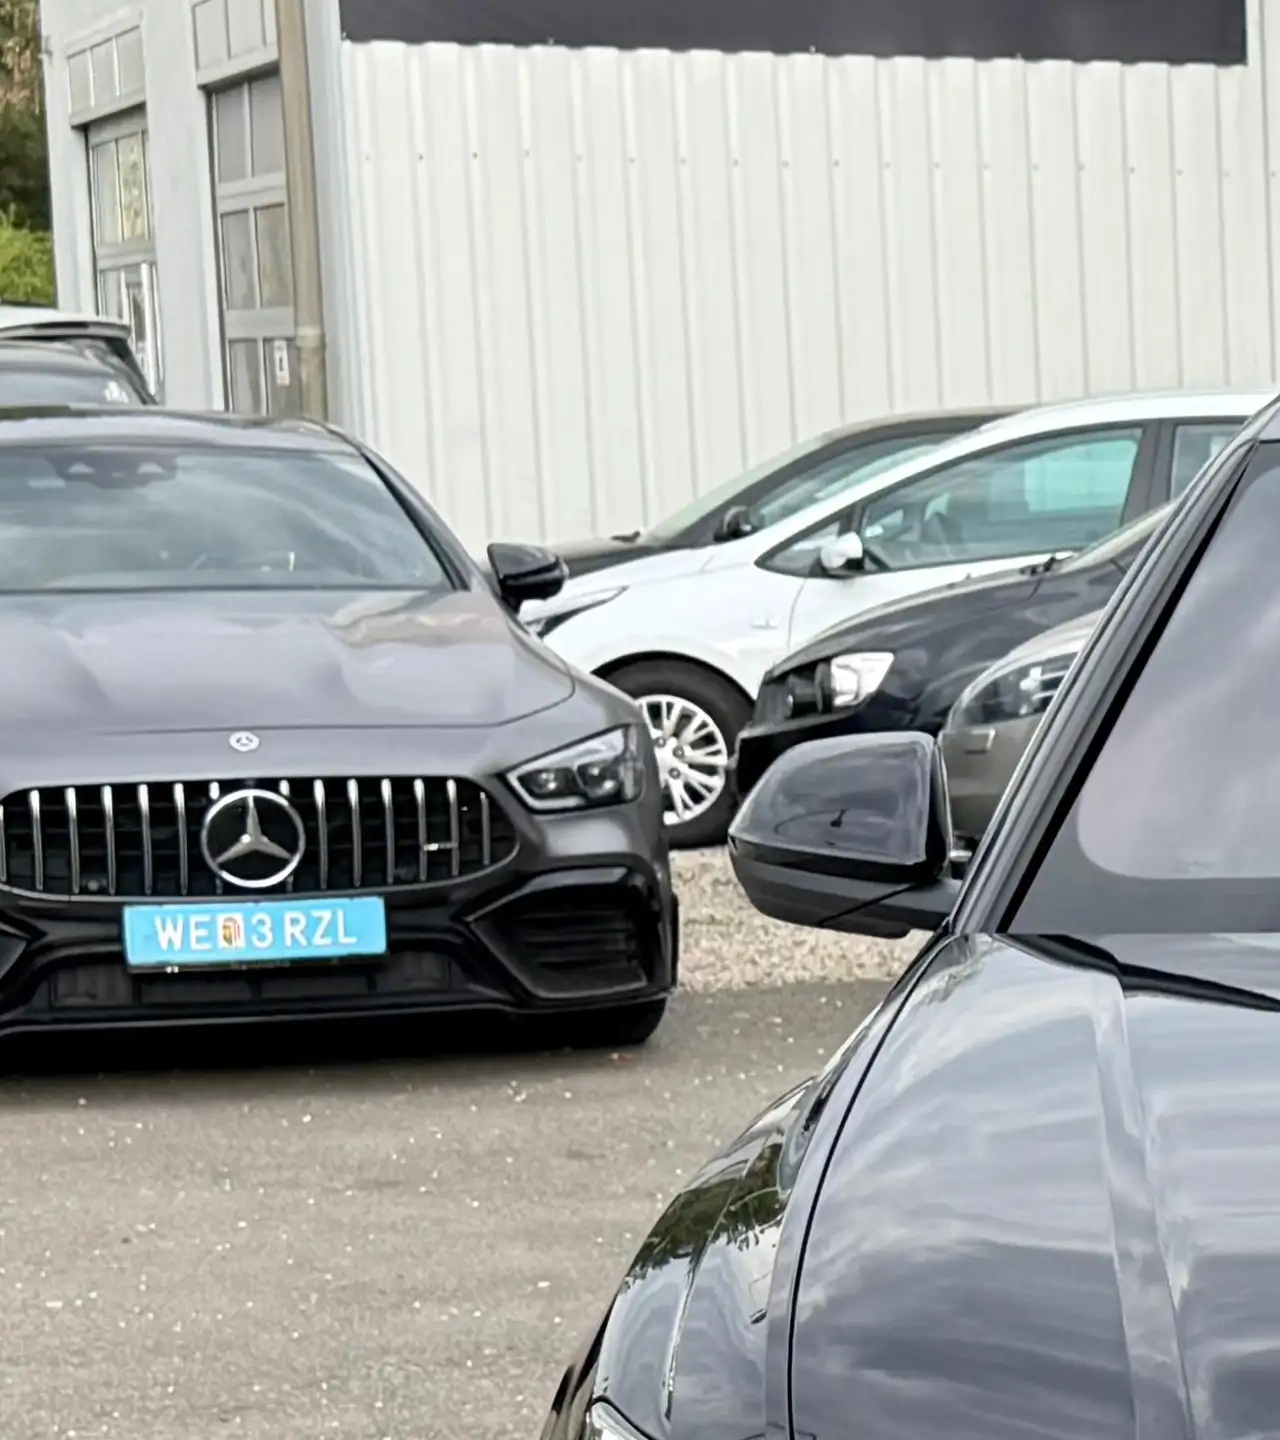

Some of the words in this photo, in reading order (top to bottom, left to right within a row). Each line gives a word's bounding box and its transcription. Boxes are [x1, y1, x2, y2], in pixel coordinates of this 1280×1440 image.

[154, 912, 212, 952] WE
[250, 912, 274, 949] 3
[283, 908, 358, 948] RZL
